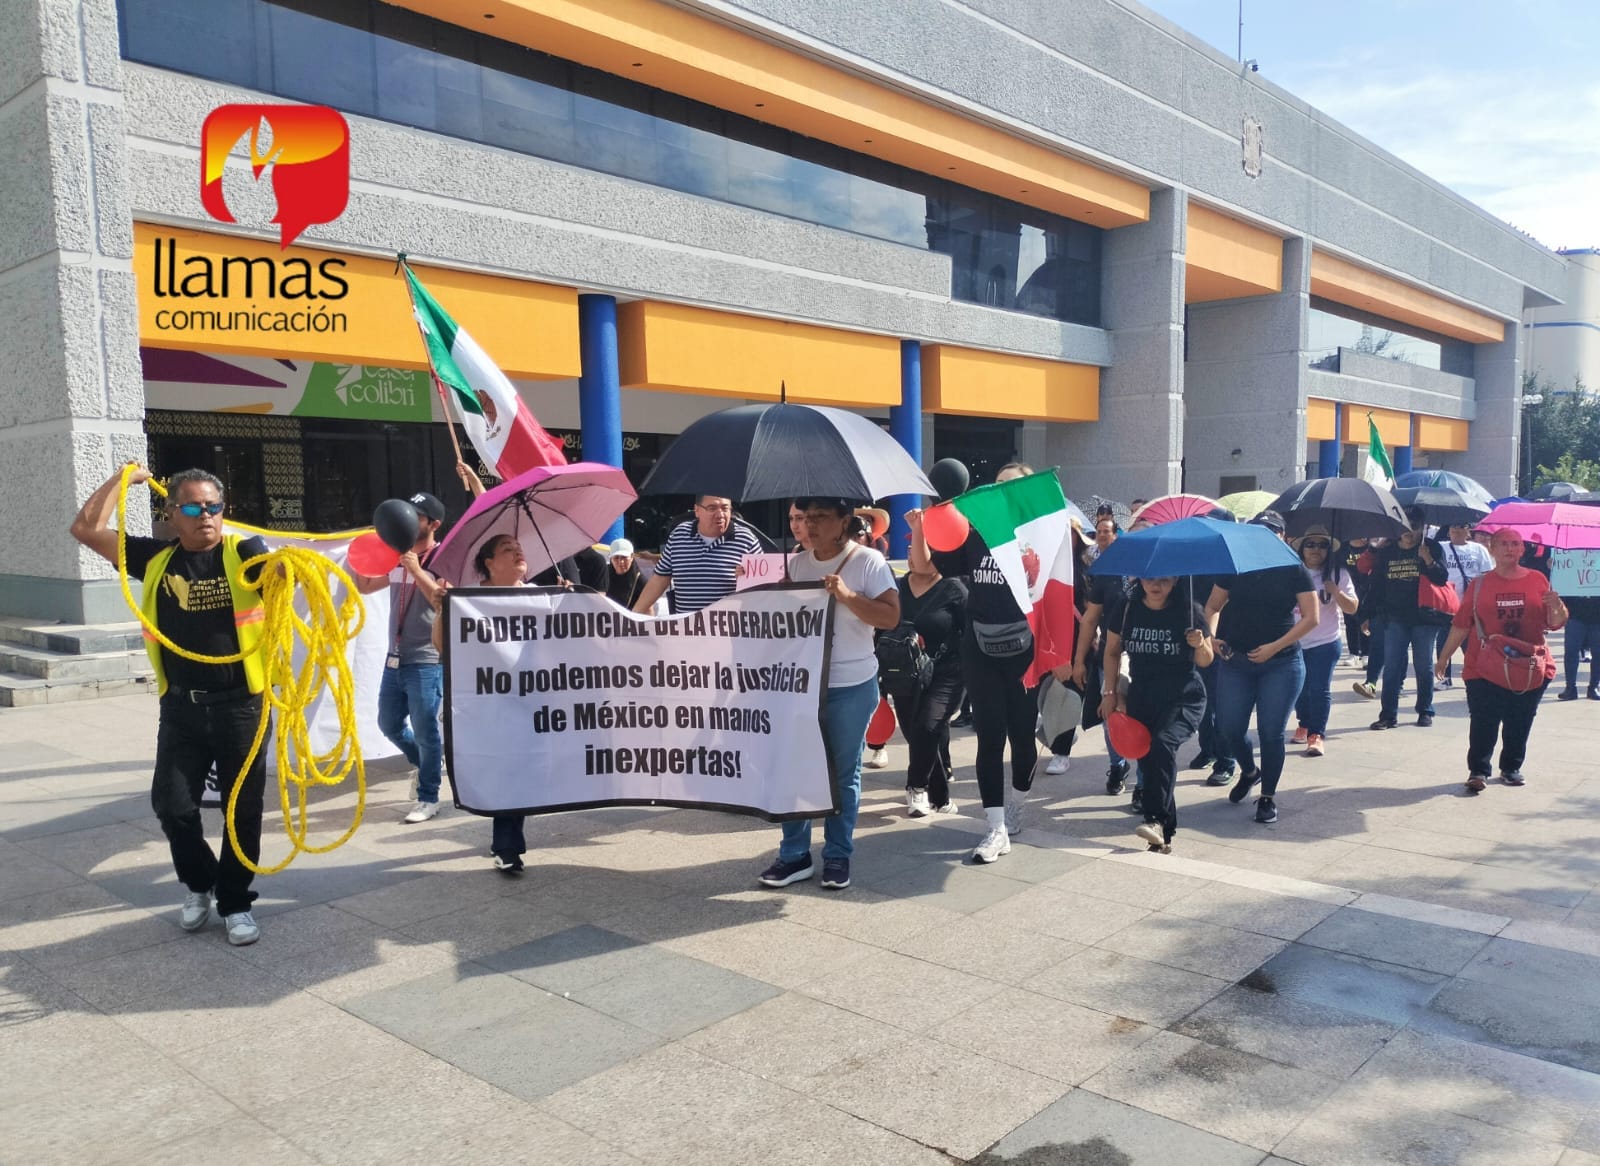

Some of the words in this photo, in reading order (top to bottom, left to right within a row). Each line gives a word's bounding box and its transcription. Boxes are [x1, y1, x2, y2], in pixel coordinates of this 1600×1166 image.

[746, 559, 769, 578] NO
[973, 570, 1005, 584] SOMOS
[460, 615, 538, 644] PODER
[543, 612, 649, 640] JUDICIAL
[655, 619, 679, 636] DE
[684, 611, 706, 636] LA
[709, 605, 824, 639] FEDERACIÓN
[1497, 608, 1524, 620] PJF
[1131, 627, 1172, 641] #TODOS
[476, 667, 512, 695] No
[519, 663, 644, 696] podemos
[650, 660, 711, 691] dejar
[714, 661, 733, 690] la
[736, 662, 809, 694] justicia
[533, 705, 567, 733] de
[574, 700, 669, 731] México
[675, 705, 704, 729] en
[710, 706, 771, 735] manos
[585, 745, 742, 778] inexpertas!
